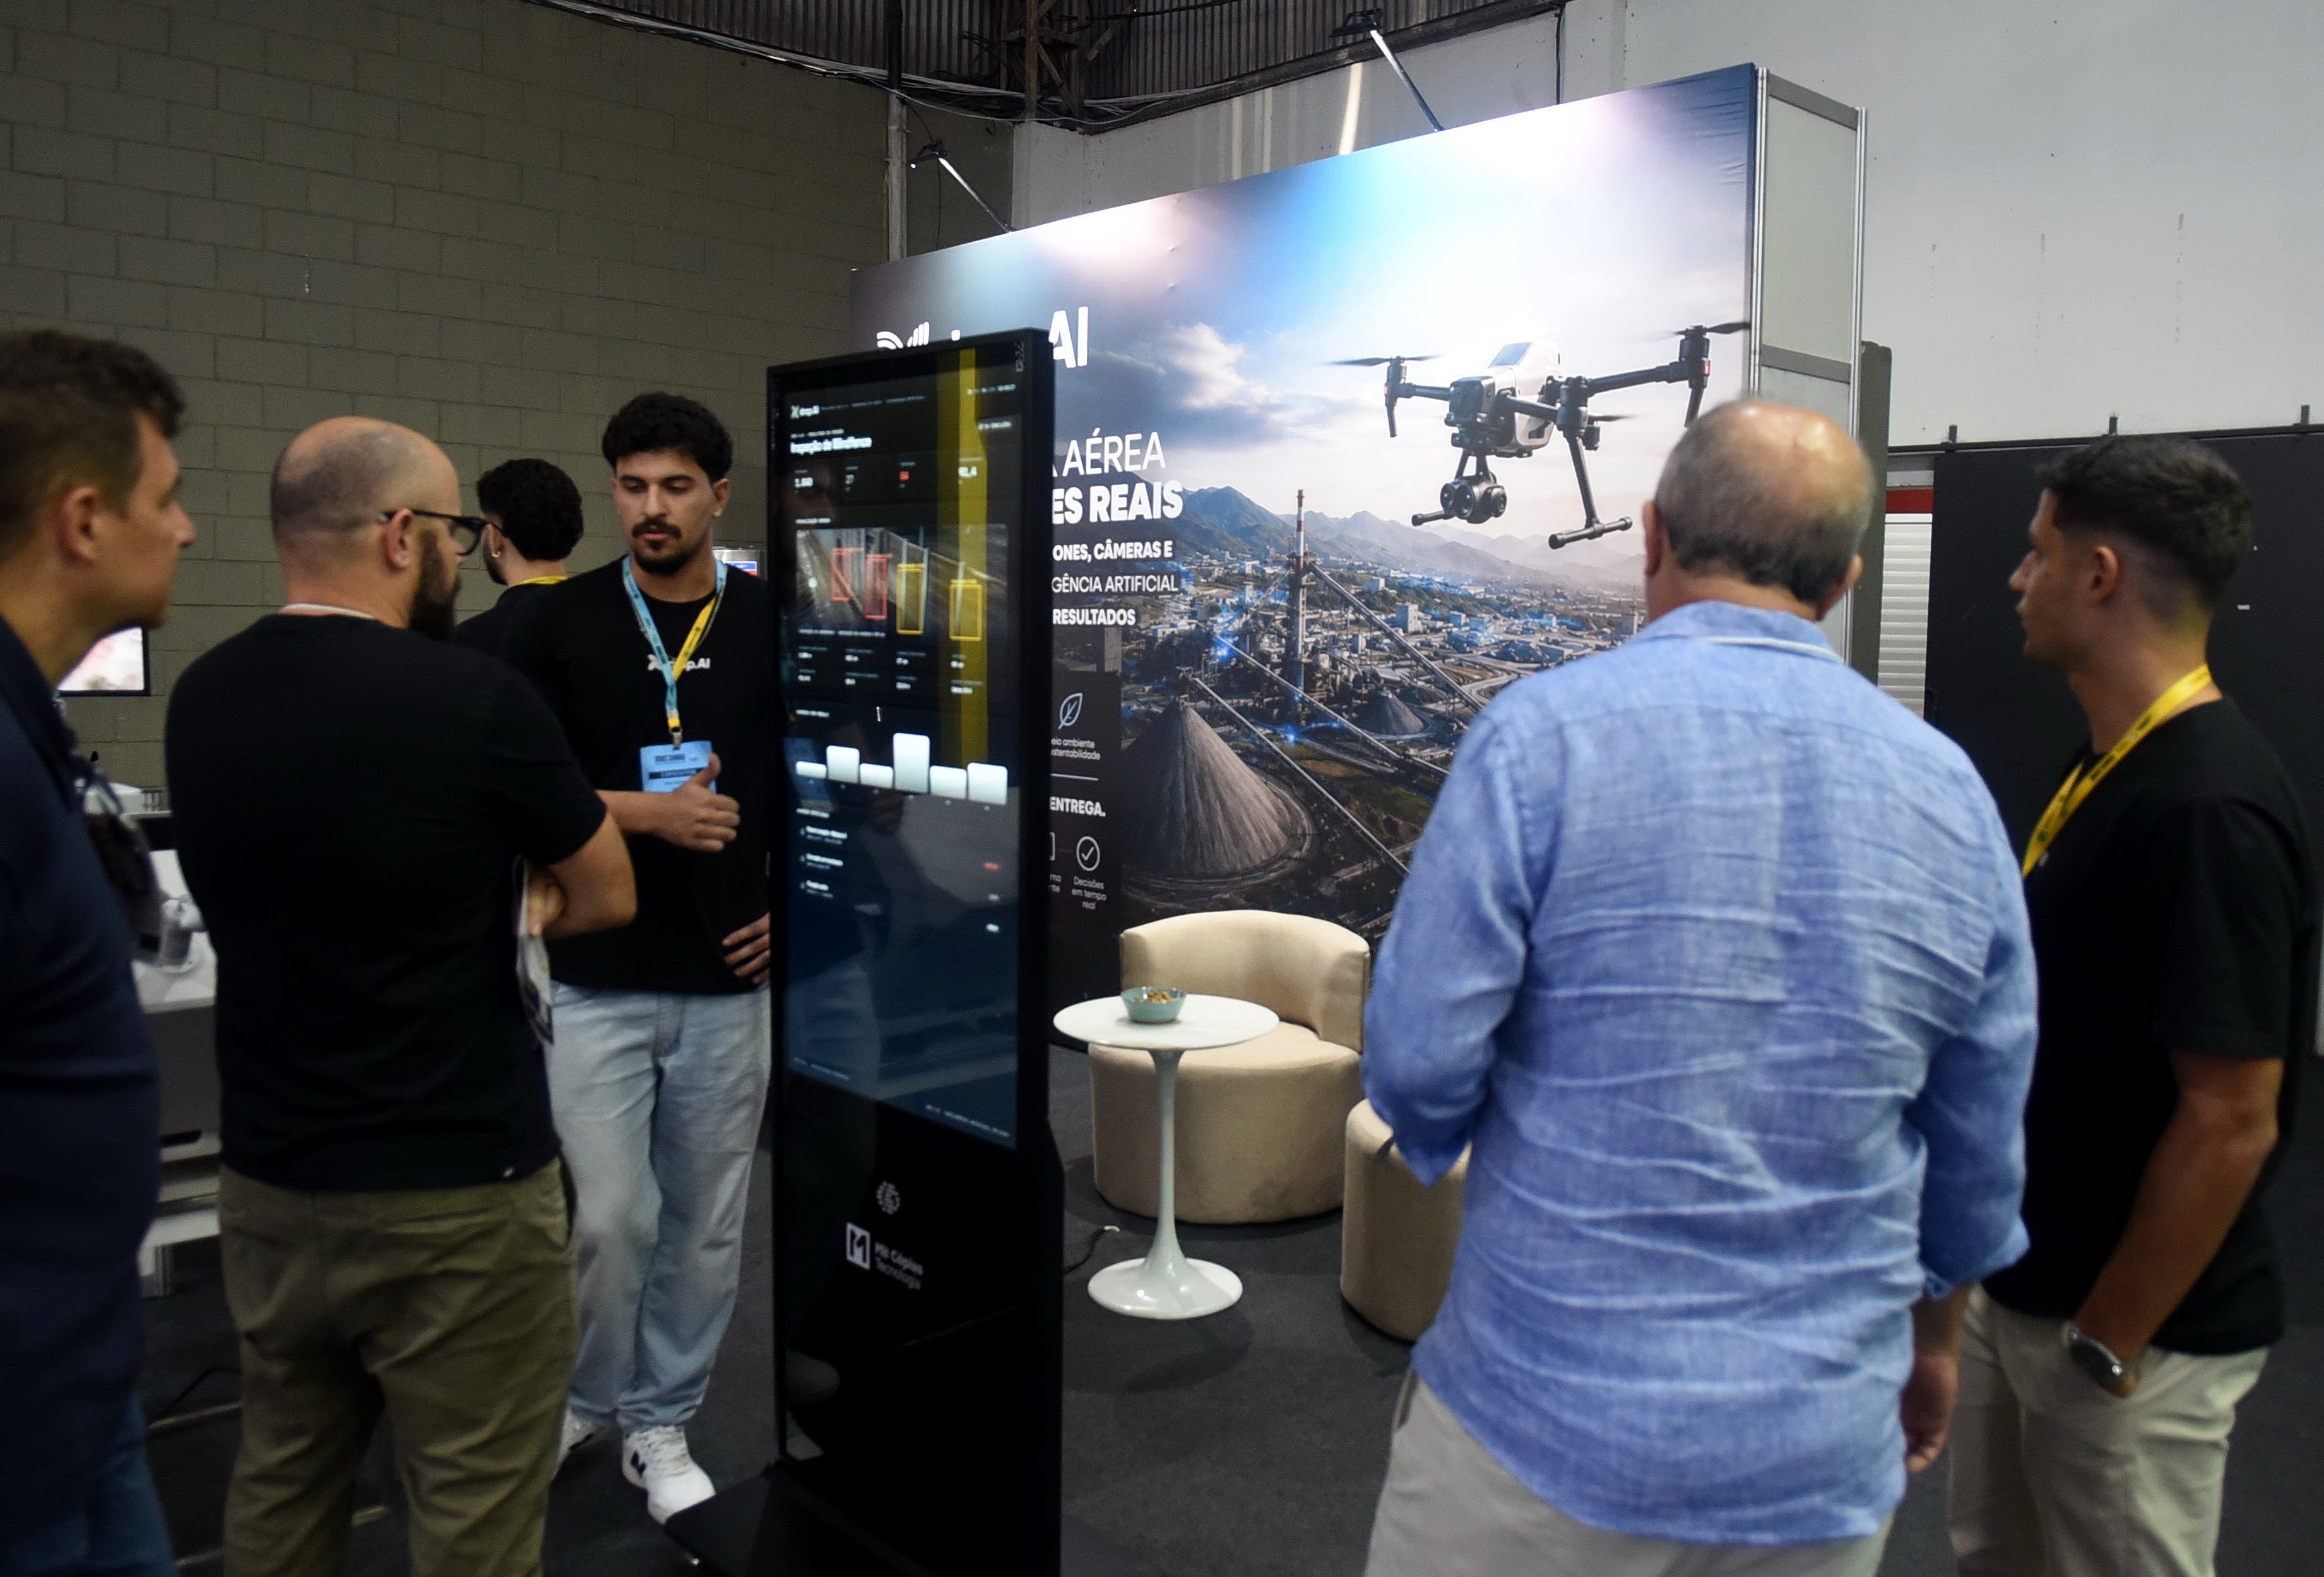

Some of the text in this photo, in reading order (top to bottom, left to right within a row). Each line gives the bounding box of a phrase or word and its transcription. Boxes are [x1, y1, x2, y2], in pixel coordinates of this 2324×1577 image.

[1048, 306, 1088, 368] AI
[1062, 427, 1166, 477] AÉREA
[1052, 480, 1183, 525] ES REAIS
[1052, 539, 1173, 563] ONES, CÂMERAS E
[1052, 573, 1179, 593] GÊNCIA ARTIFICIAL
[1052, 609, 1136, 626] RESULTADOS
[1051, 737, 1096, 749] eio ambiente
[1050, 797, 1106, 817] ENTREGA.
